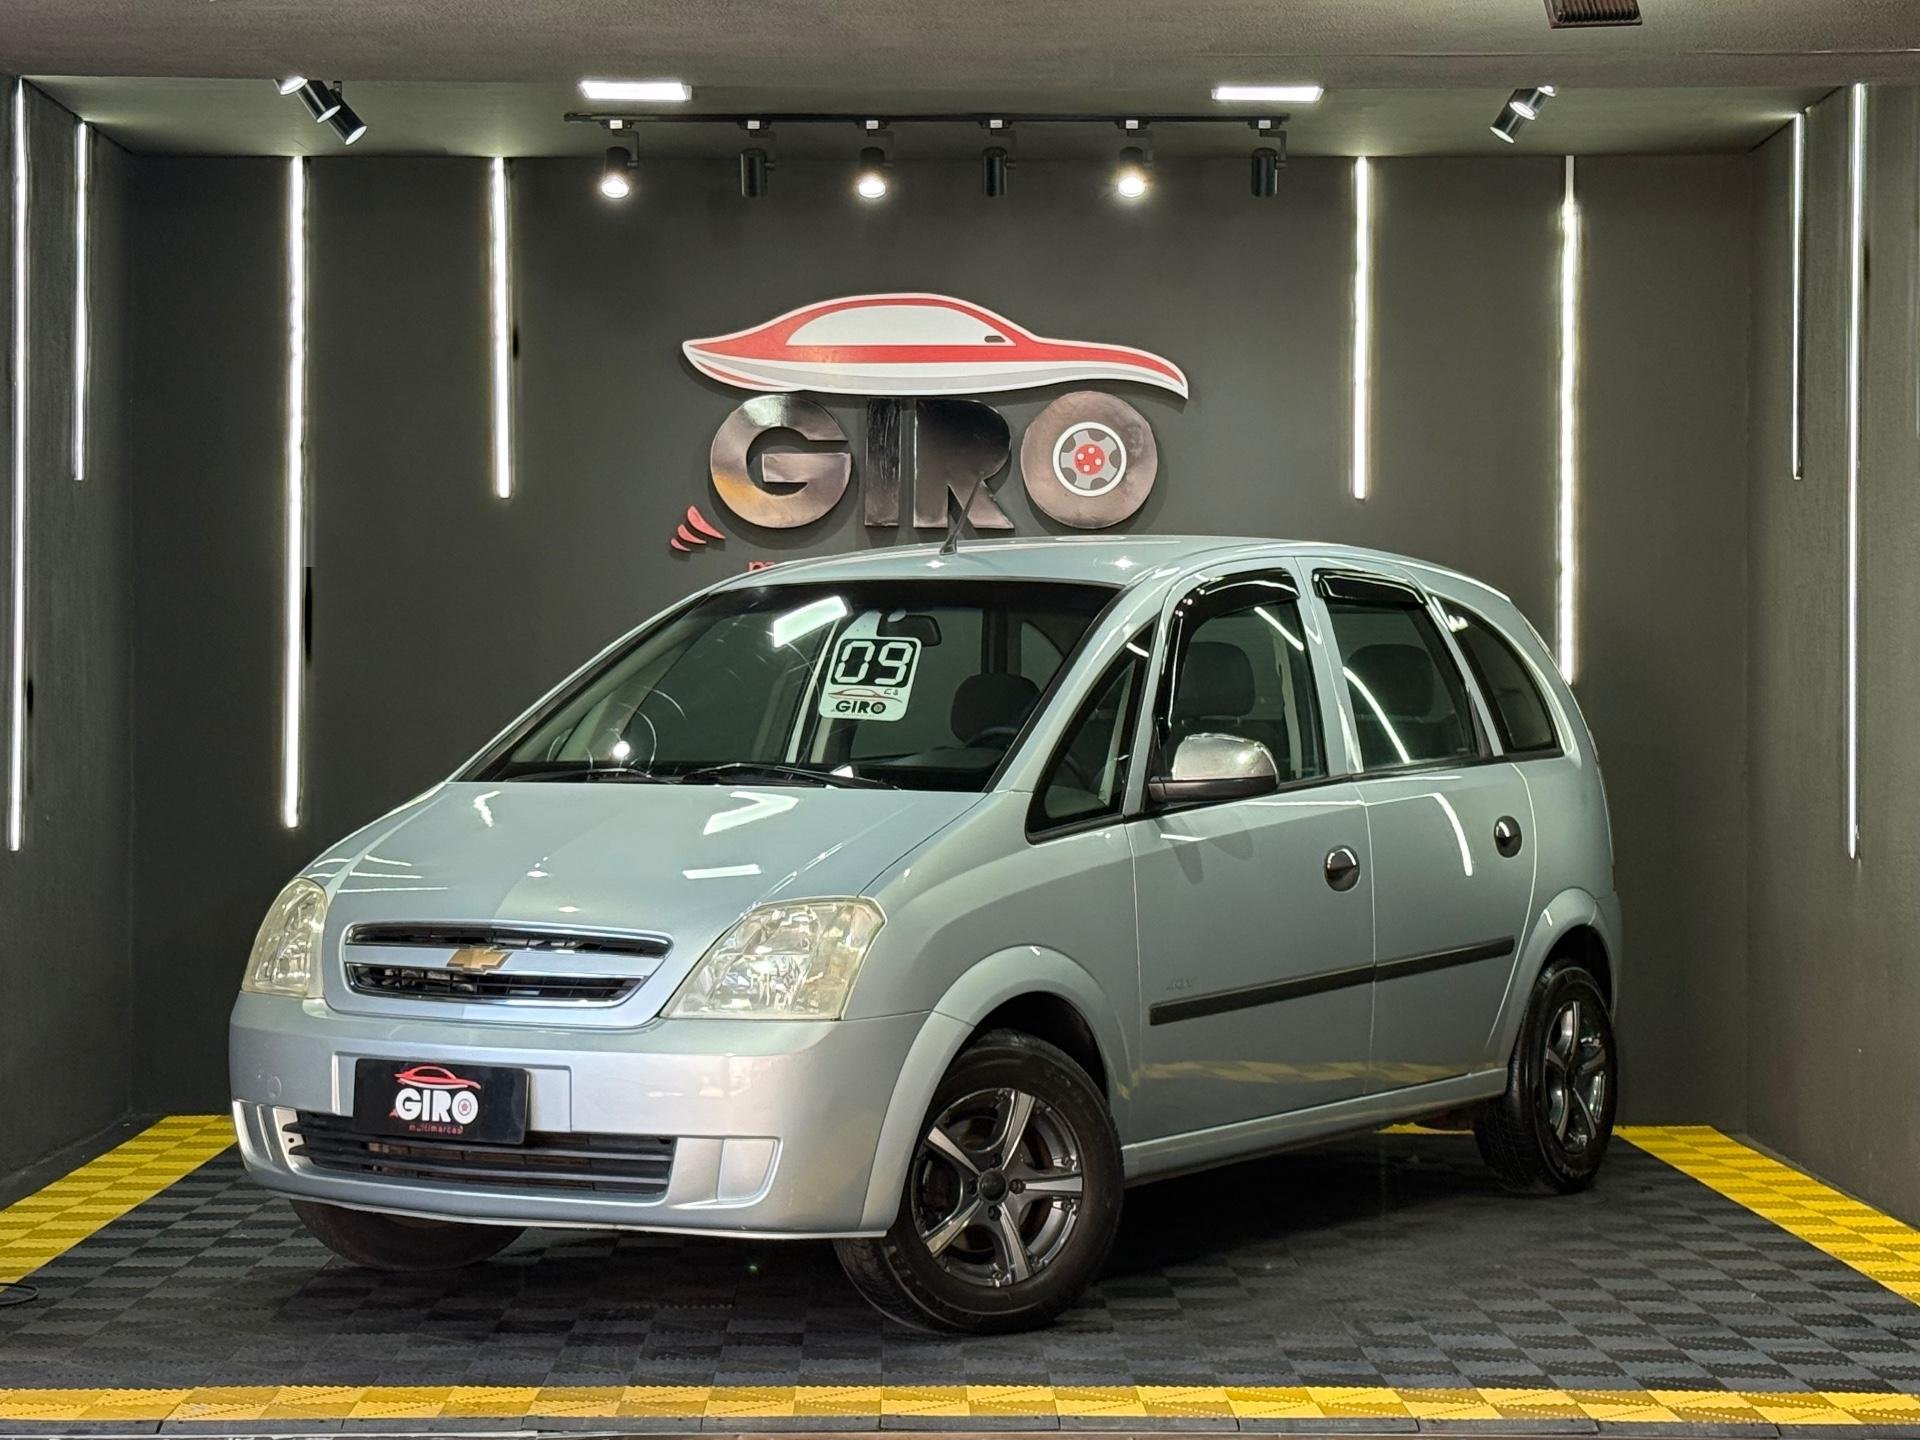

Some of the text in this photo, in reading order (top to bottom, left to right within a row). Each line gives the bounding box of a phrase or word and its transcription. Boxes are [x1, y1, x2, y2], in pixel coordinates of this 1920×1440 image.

[710, 391, 1158, 529] GIRO
[834, 640, 913, 685] 09
[835, 700, 886, 714] GIRO
[395, 1087, 479, 1125] GIRO
